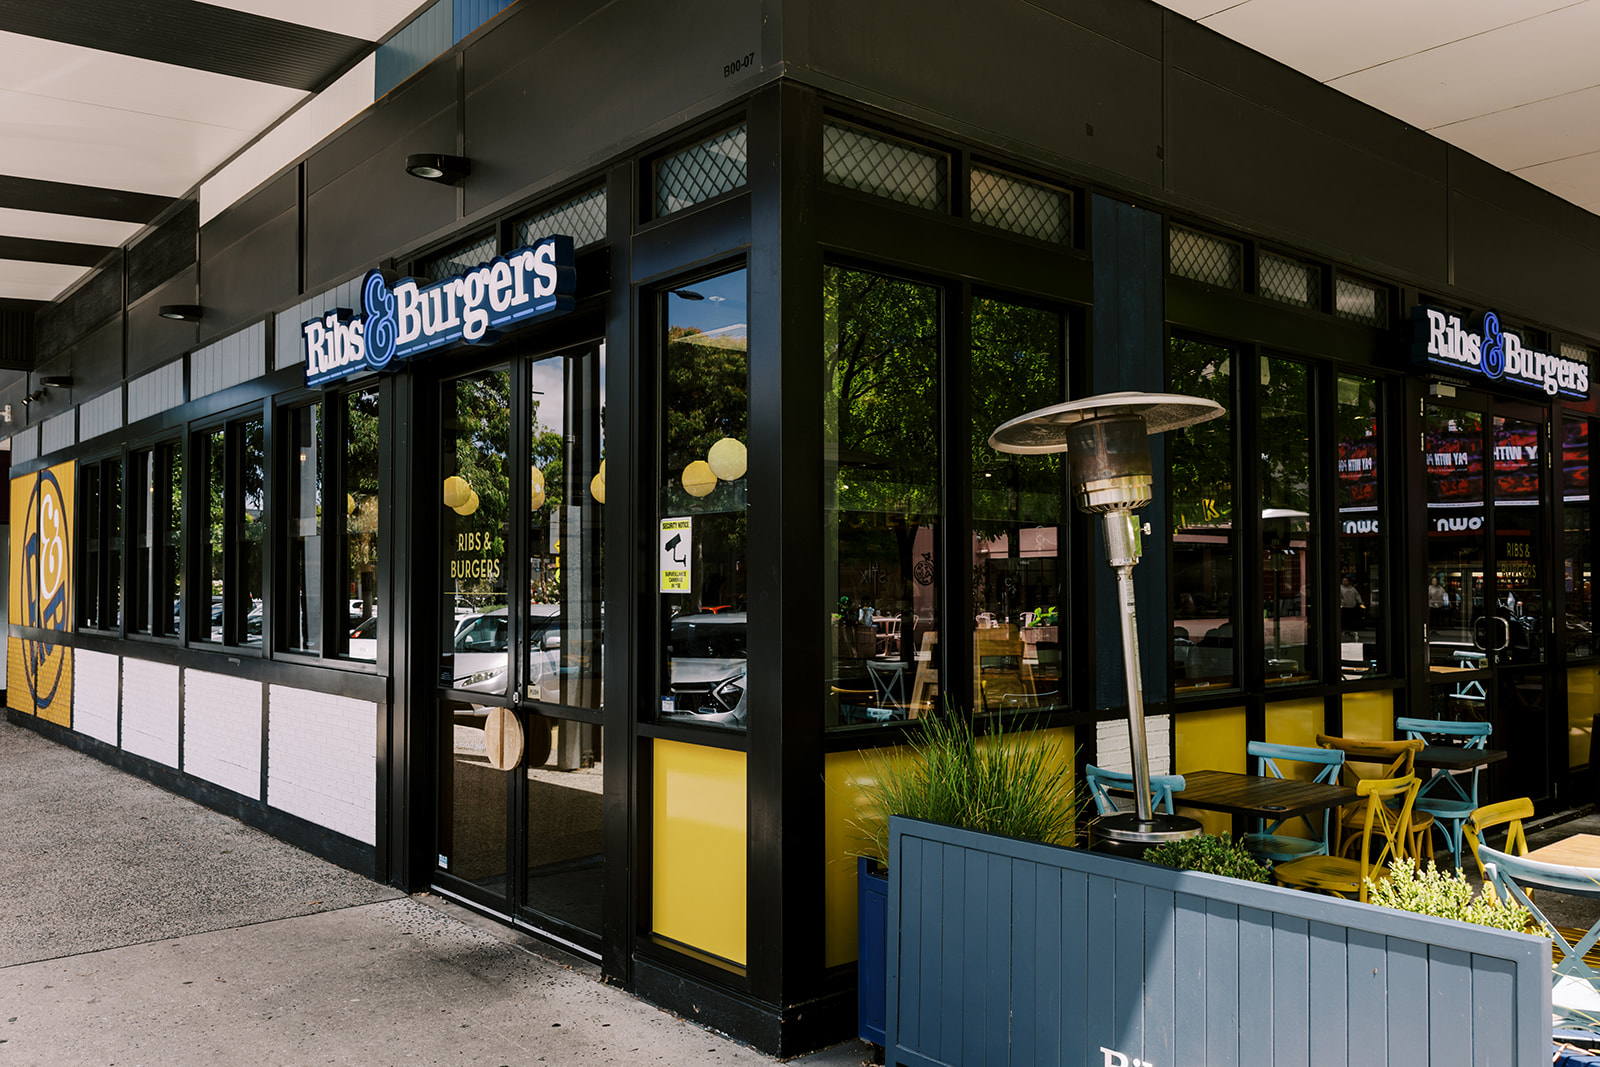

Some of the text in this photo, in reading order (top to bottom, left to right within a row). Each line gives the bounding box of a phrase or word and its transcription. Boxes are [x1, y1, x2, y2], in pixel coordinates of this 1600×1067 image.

[723, 52, 755, 78] B00-07
[304, 241, 558, 377] Ribs & Burgers
[1427, 308, 1589, 396] Ribs & Burgers
[662, 521, 689, 530] SECURITY NOTICE
[458, 531, 492, 551] RIBS &
[1506, 542, 1524, 558] RIBS
[450, 558, 500, 579] BURGERS
